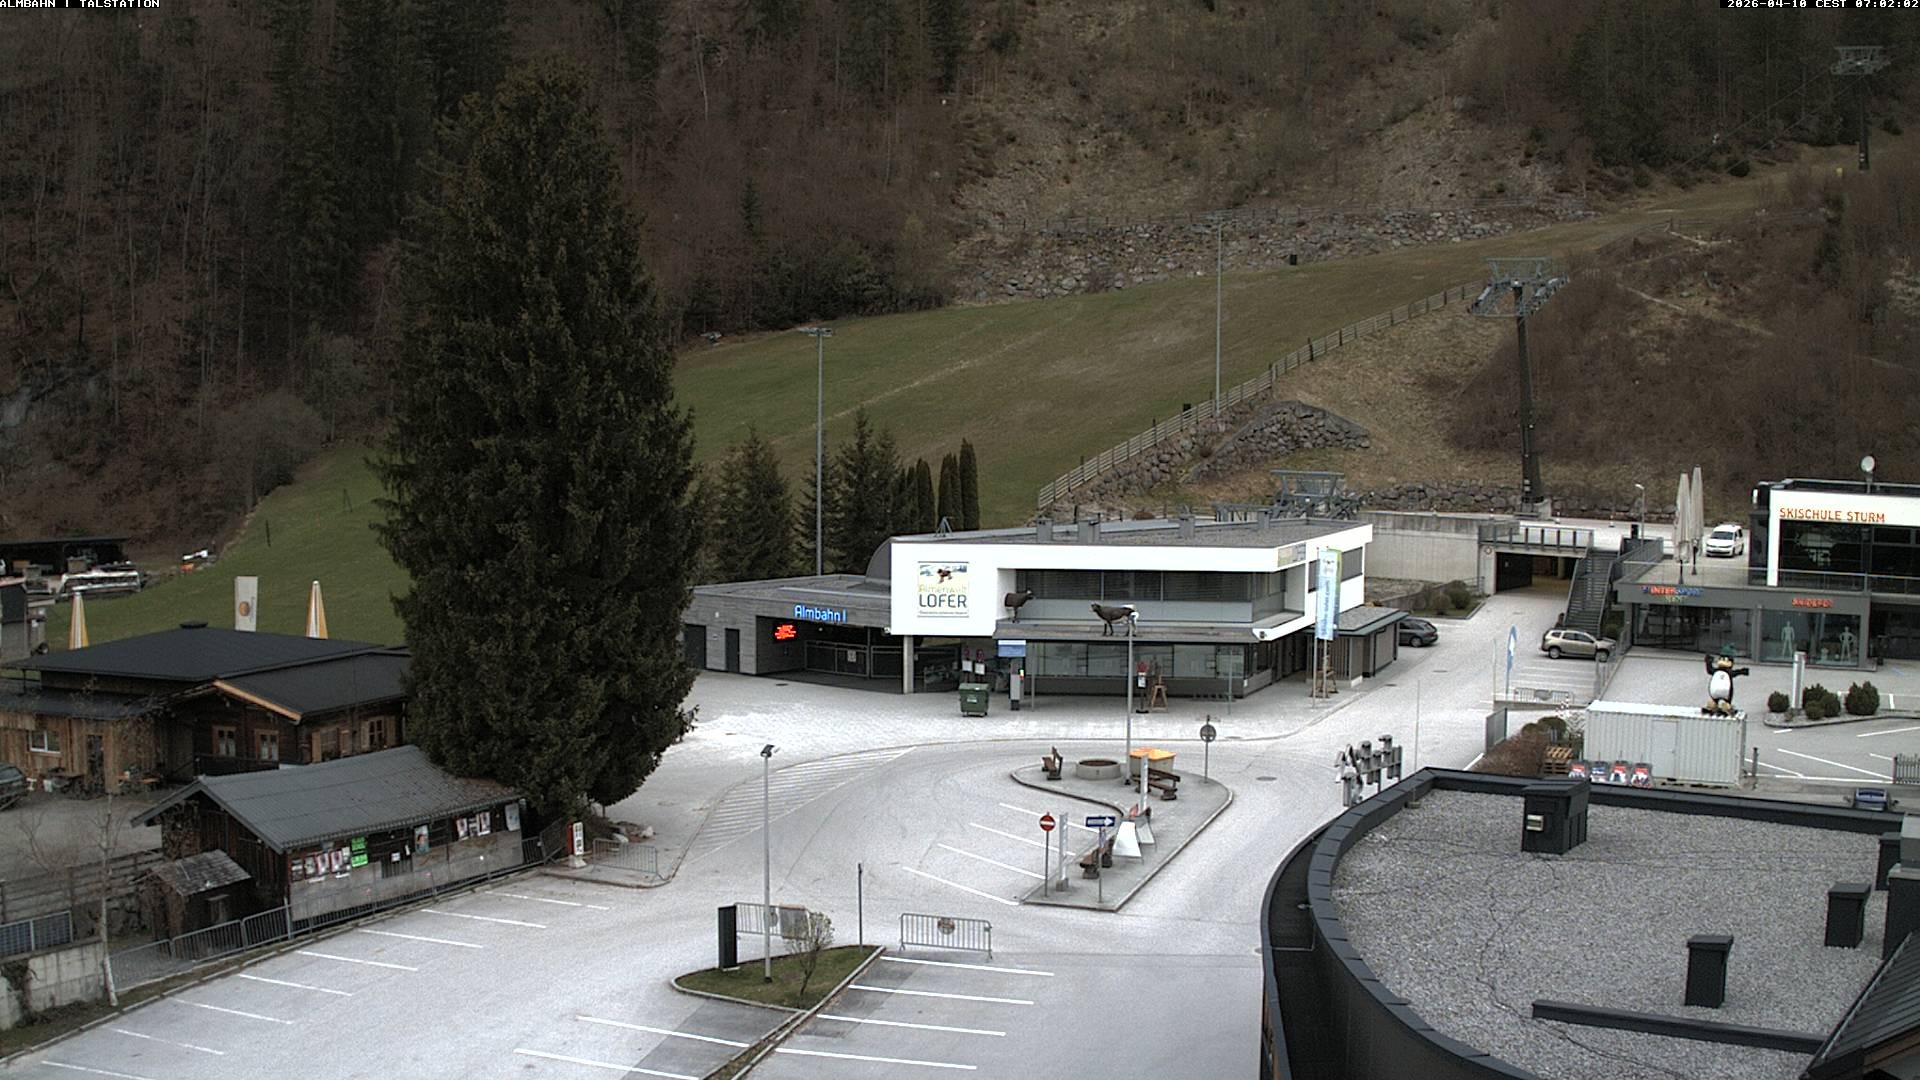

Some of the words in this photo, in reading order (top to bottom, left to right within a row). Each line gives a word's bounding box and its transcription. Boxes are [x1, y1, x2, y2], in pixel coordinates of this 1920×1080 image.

[1779, 507, 1842, 521] SKISCHULE
[1846, 511, 1886, 523] STURM
[918, 593, 968, 608] LOFER
[794, 604, 842, 622] Almbahn
